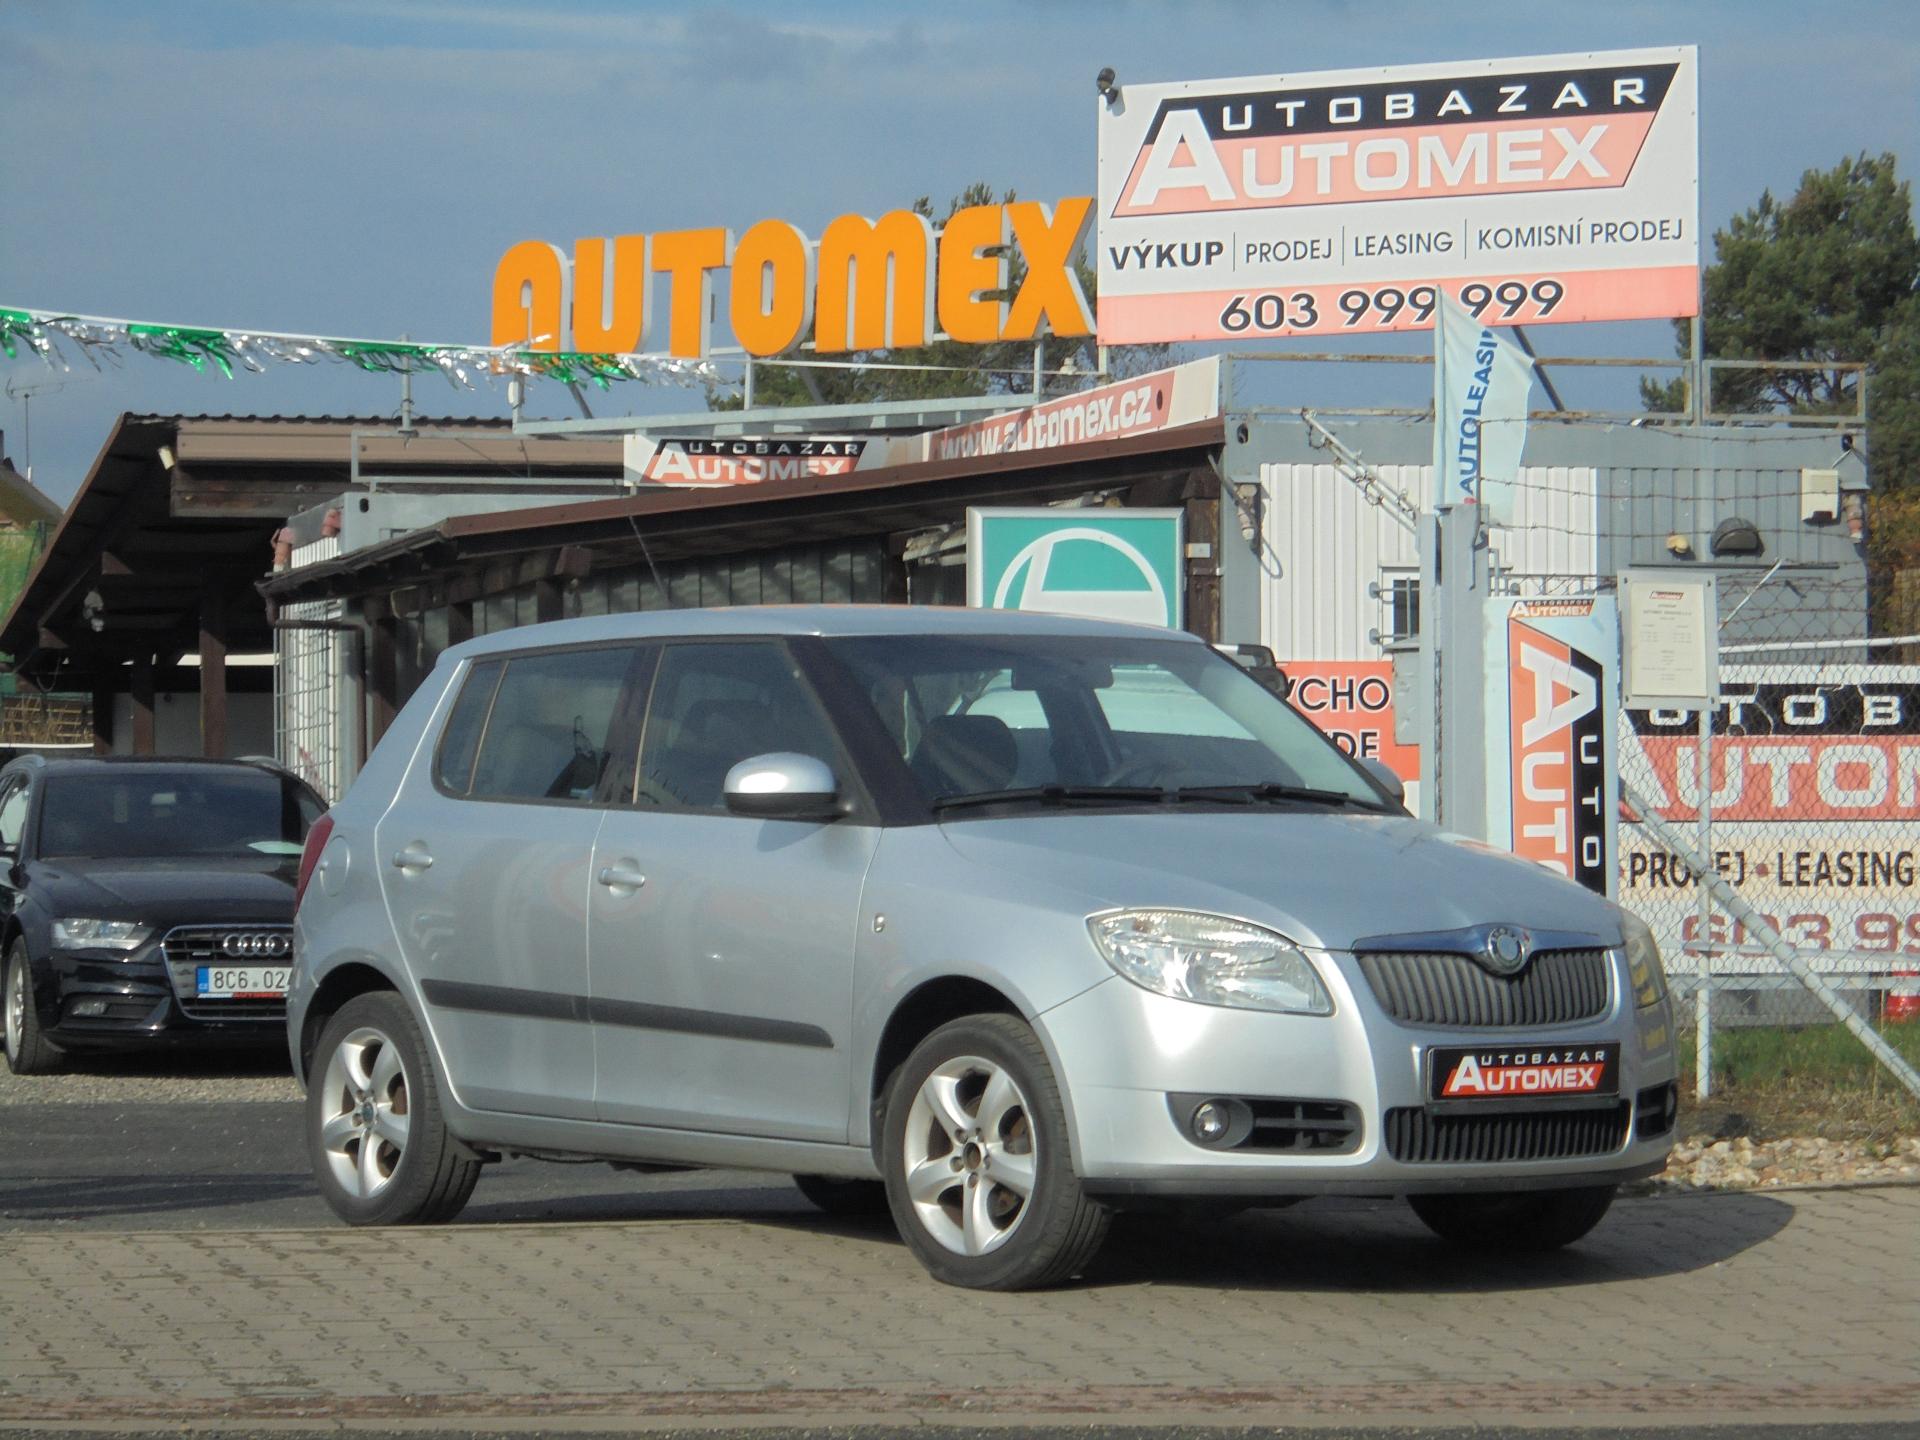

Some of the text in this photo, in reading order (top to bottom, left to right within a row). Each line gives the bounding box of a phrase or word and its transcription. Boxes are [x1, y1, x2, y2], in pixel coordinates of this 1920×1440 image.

[1128, 109, 1609, 207] AUTOMEX
[1109, 217, 1682, 271] VÝKUP PRODEJ LEASING KOMISNÍ PRODEJ
[490, 197, 1097, 358] AUTOMEX
[1219, 279, 1565, 333] 603 999 999
[650, 442, 844, 481] AUTOMEX
[1510, 601, 1588, 617] AUTOMEX
[1629, 850, 1914, 888] PROEJ LEASING
[1682, 913, 1832, 958] 603
[214, 970, 291, 989] 8C6 02
[1449, 1055, 1596, 1092] AUTOMEX
